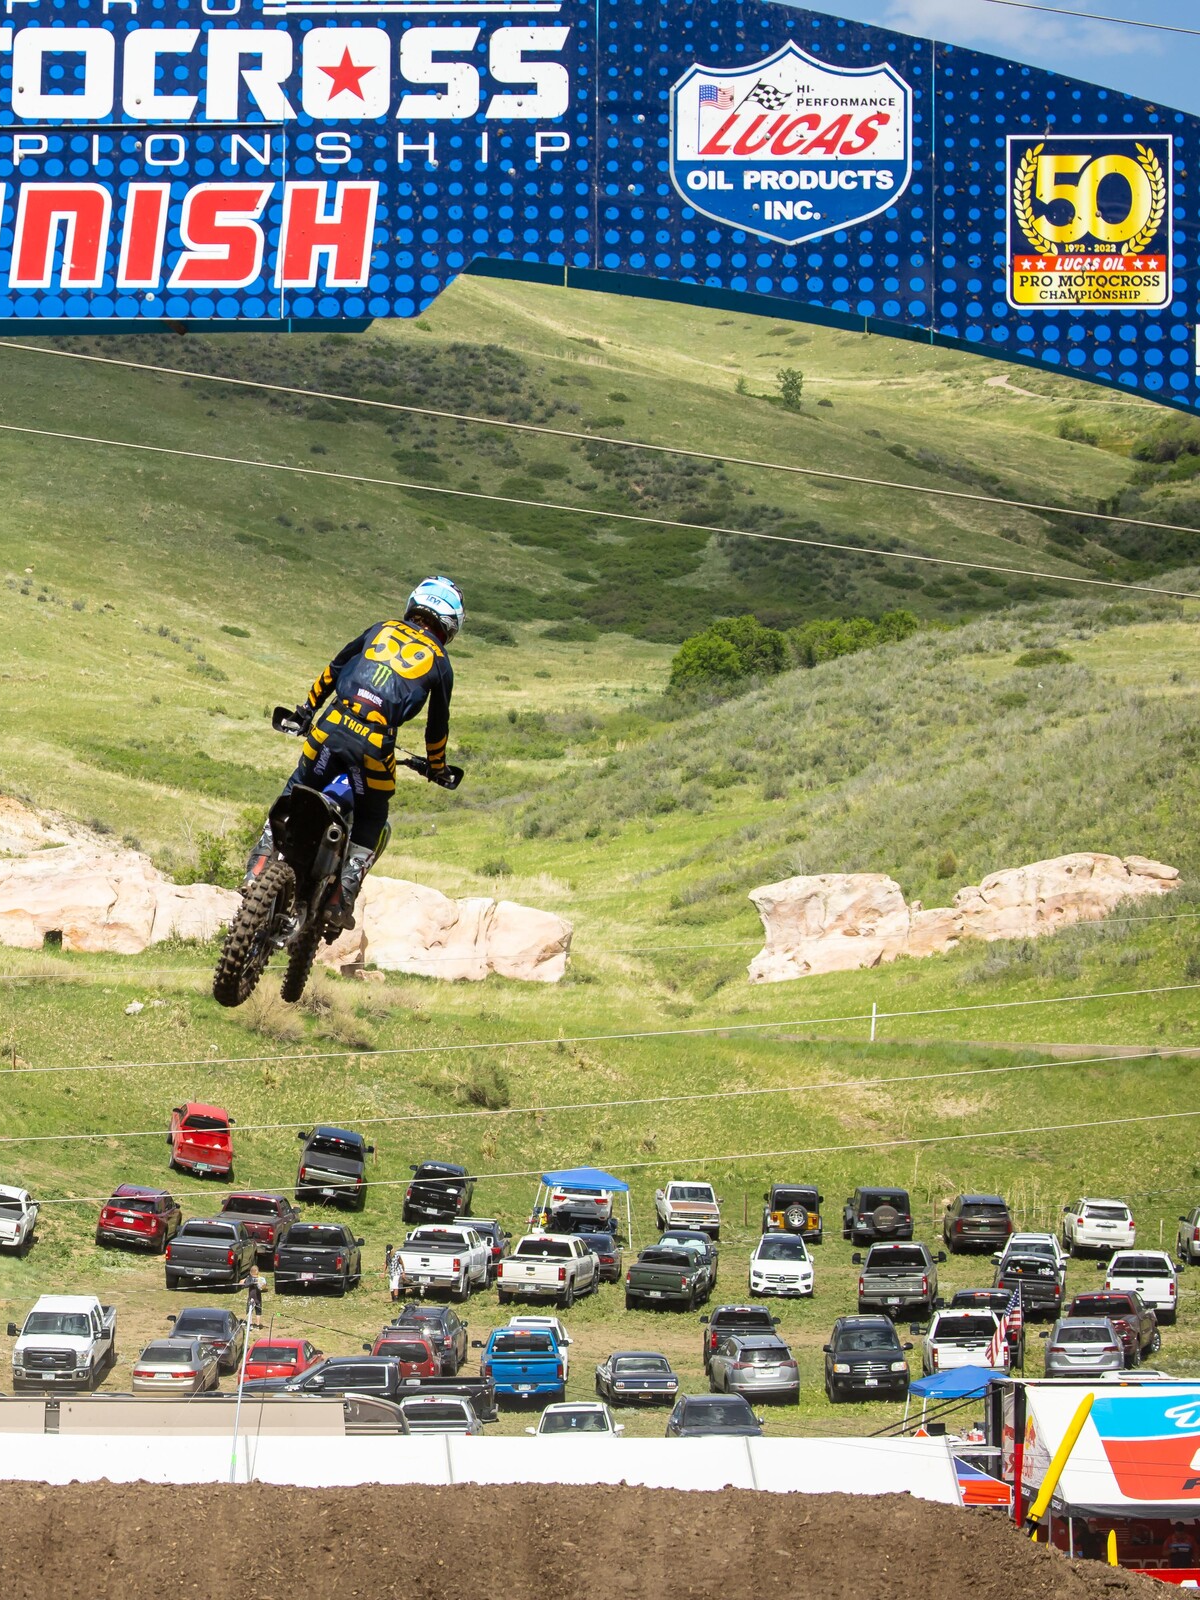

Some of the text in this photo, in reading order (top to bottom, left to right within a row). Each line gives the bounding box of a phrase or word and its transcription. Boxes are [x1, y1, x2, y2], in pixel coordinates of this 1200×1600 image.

[797, 85, 815, 94] HI-
[797, 98, 896, 107] PERFORMANCE
[699, 113, 891, 155] LUCAS
[687, 169, 894, 190] OIL PRODUCTS
[1031, 154, 1152, 243] 50
[1064, 244, 1085, 252] 1972
[1094, 244, 1116, 252] 2022
[1054, 257, 1124, 271] LUCAS OIL
[1020, 275, 1160, 287] PRO MOTOCROSS
[1039, 289, 1141, 301] CHAMPIONSHIP
[364, 626, 435, 680] 59
[343, 714, 371, 737] THOR
